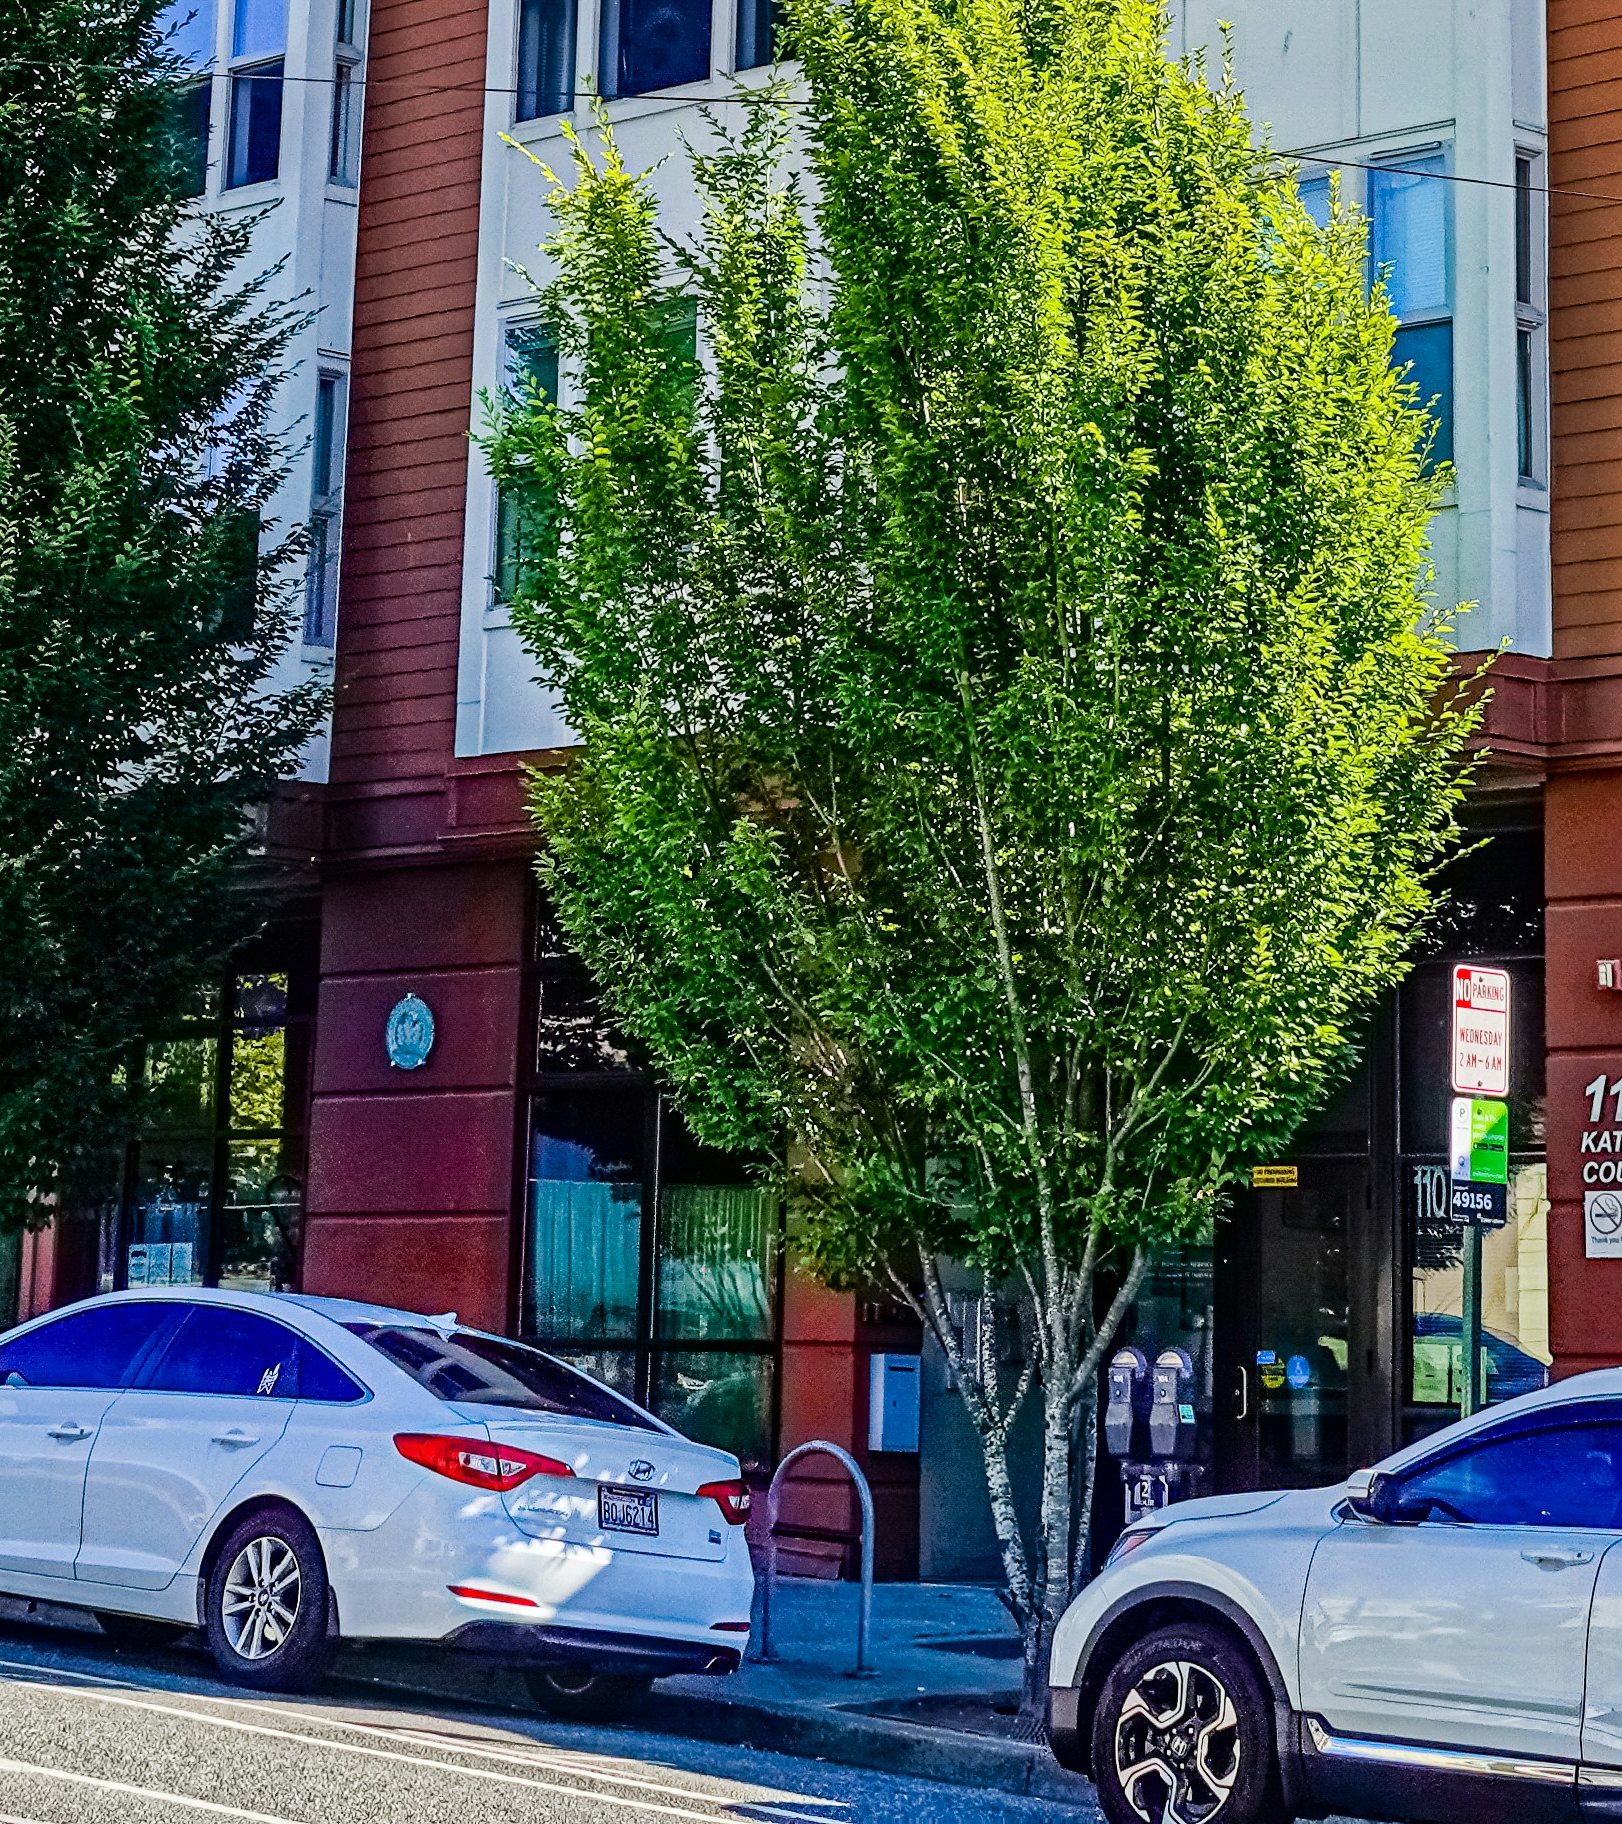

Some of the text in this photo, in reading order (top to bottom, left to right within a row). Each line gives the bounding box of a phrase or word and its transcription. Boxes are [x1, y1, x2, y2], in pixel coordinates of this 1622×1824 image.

[1456, 978, 1505, 1002] NO PARKING
[1460, 1027, 1503, 1047] WEDNESDAY
[1460, 1052, 1464, 1067] 2
[1466, 1053, 1477, 1069] AM
[1492, 1057, 1502, 1072] AM
[1413, 1165, 1447, 1218] 110
[1452, 1191, 1492, 1210] 49156
